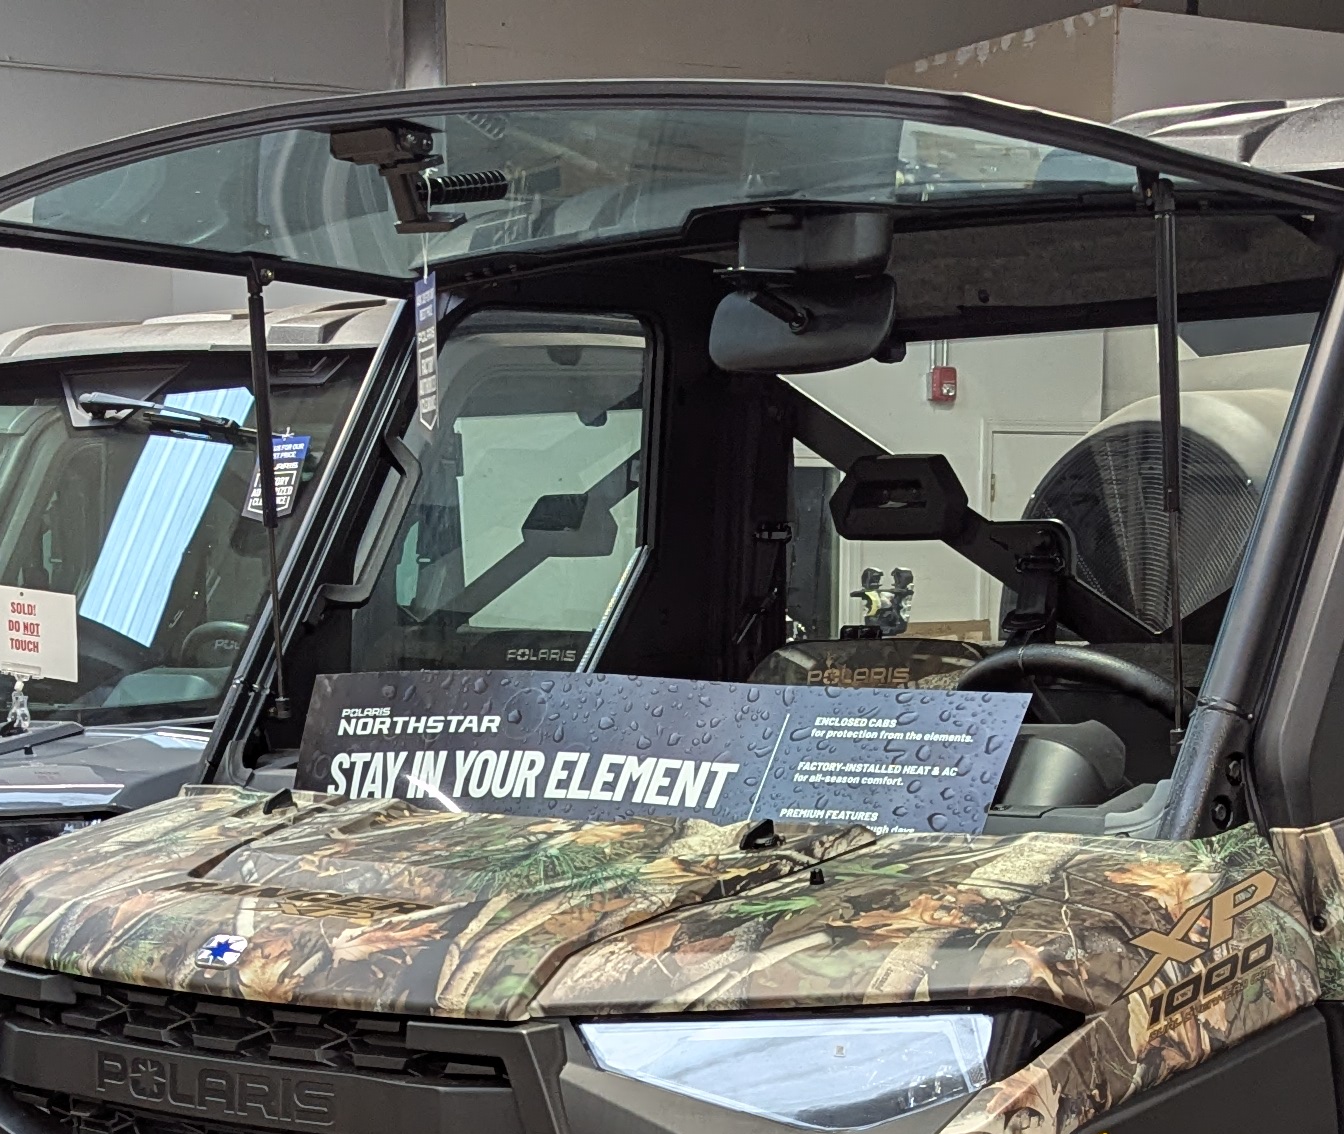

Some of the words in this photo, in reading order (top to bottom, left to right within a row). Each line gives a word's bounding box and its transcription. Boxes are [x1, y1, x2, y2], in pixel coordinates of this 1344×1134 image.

[10, 601, 37, 616] SOLD!
[8, 619, 21, 633] DO
[22, 621, 40, 636] NOT
[9, 637, 40, 653] TOUCH
[506, 648, 577, 663] POLARIS
[807, 666, 910, 686] POLARIS
[342, 707, 392, 718] POLARIS
[337, 715, 502, 737] NORTHSTAR
[814, 716, 868, 728] ENCLOSED
[868, 718, 898, 729] CABS
[810, 728, 825, 738] for
[825, 729, 878, 740] protection
[879, 730, 904, 740] from
[905, 731, 923, 741] the
[923, 732, 974, 743] elements.
[797, 762, 902, 774] FACTORY-INSTALLED
[902, 766, 930, 776] HEAT
[930, 766, 940, 776] &
[941, 767, 959, 777] AC
[327, 750, 408, 800] STAY
[406, 750, 448, 800] IN
[453, 750, 547, 800] YOUR
[543, 751, 741, 810] ELEMENT
[793, 773, 809, 782] for
[808, 774, 860, 784] all-season
[861, 775, 904, 787] comfort.
[779, 808, 825, 819] PREMIUM
[825, 810, 879, 822] FEATURES
[1112, 870, 1279, 1004] XP
[1147, 932, 1275, 1028] 1000
[94, 1048, 338, 1127] POLARIS
